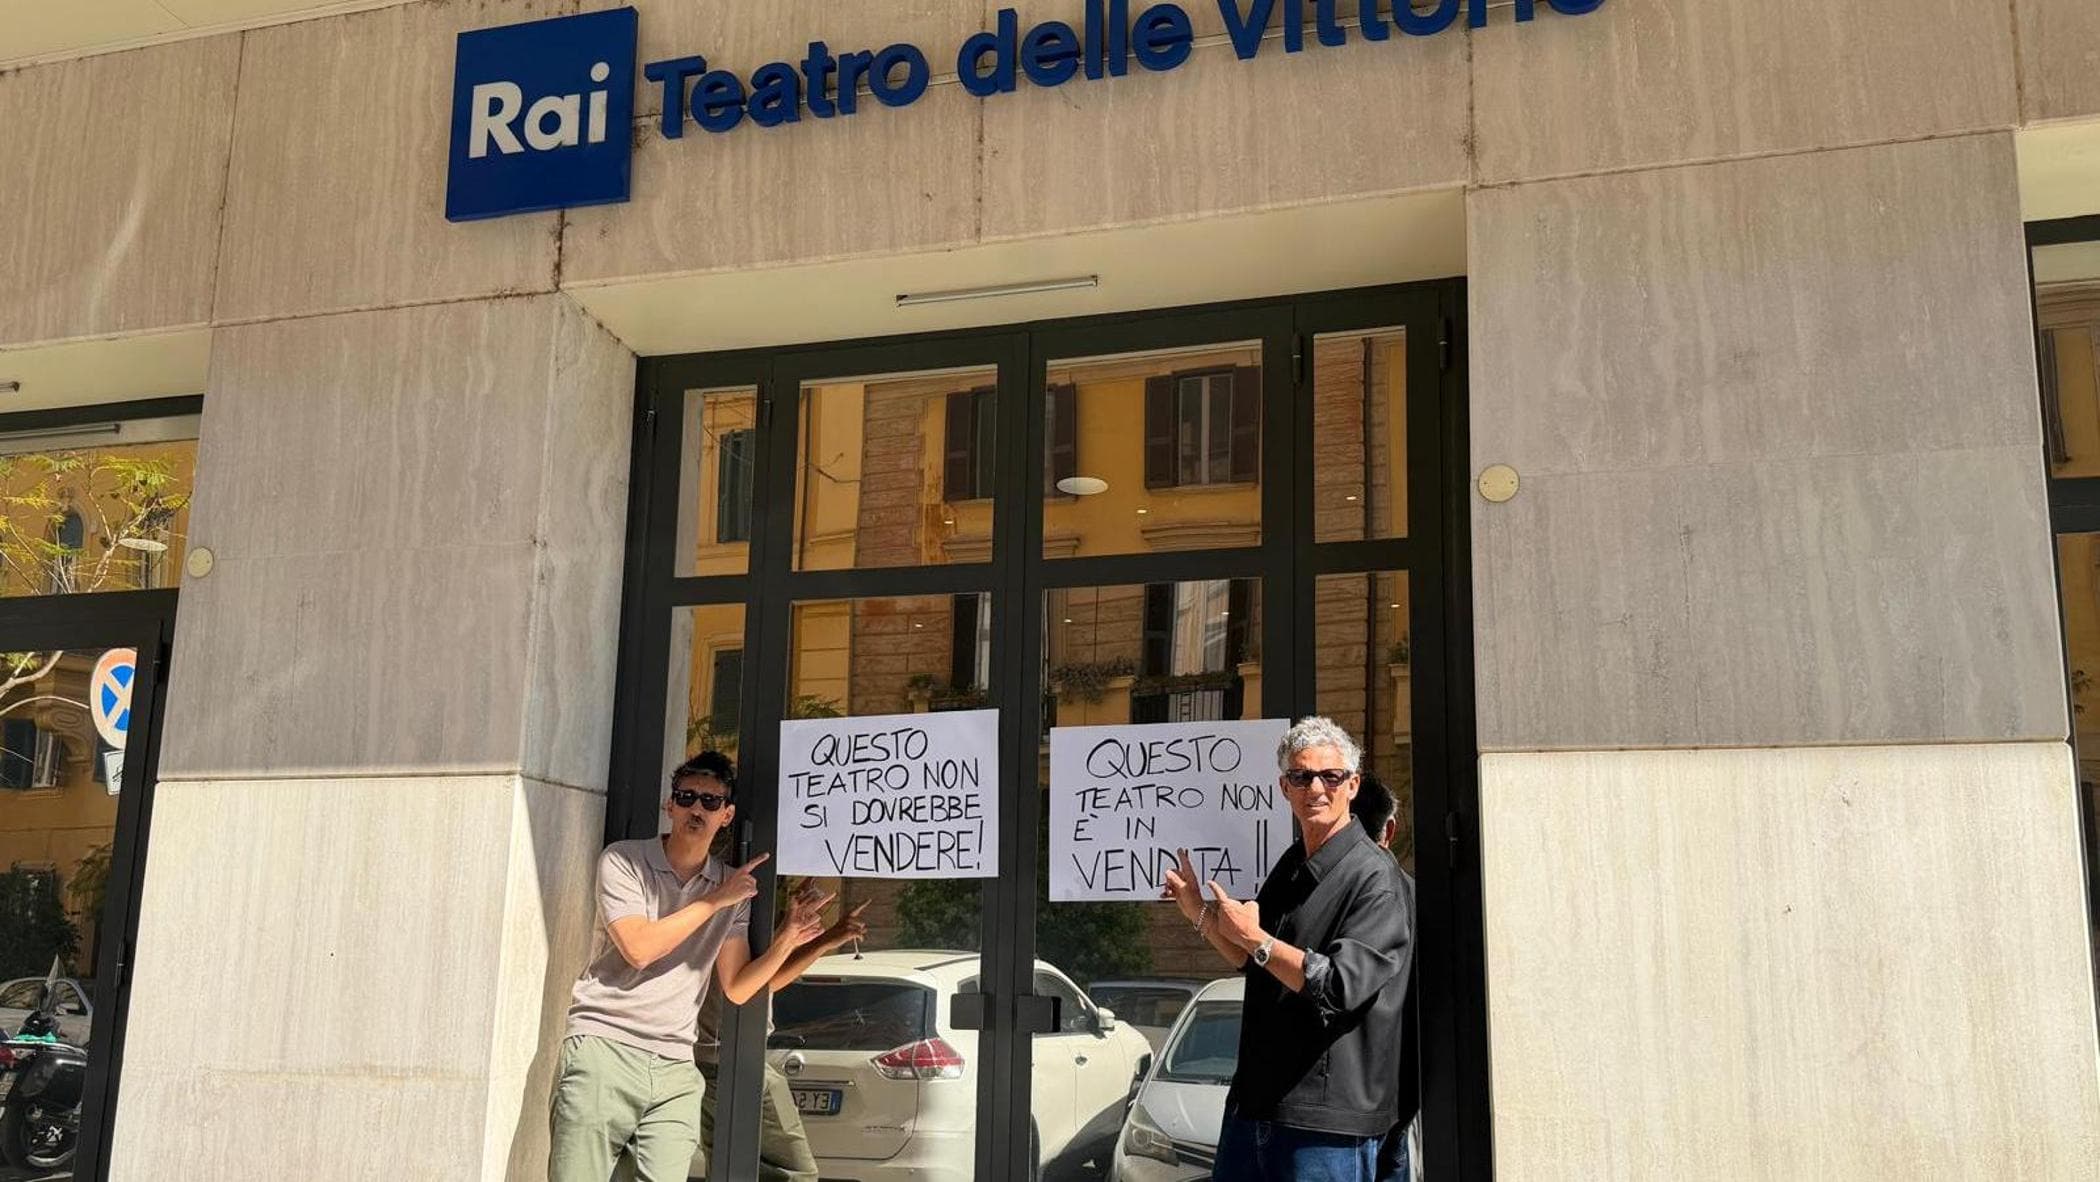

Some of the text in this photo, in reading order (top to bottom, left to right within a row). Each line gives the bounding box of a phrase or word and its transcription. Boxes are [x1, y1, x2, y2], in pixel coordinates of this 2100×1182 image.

[644, 41, 930, 140] Teatro
[956, 0, 1194, 98] delle
[468, 61, 609, 159] Rai
[811, 727, 928, 767] QUESTO
[1086, 735, 1241, 779] QUESTO
[788, 757, 979, 798] TEATRO NON
[1075, 784, 1273, 812] TEATRO NON
[799, 794, 983, 829] SI DOVREBBE
[1073, 812, 1155, 841] È IN
[824, 820, 984, 875] VENDERE!
